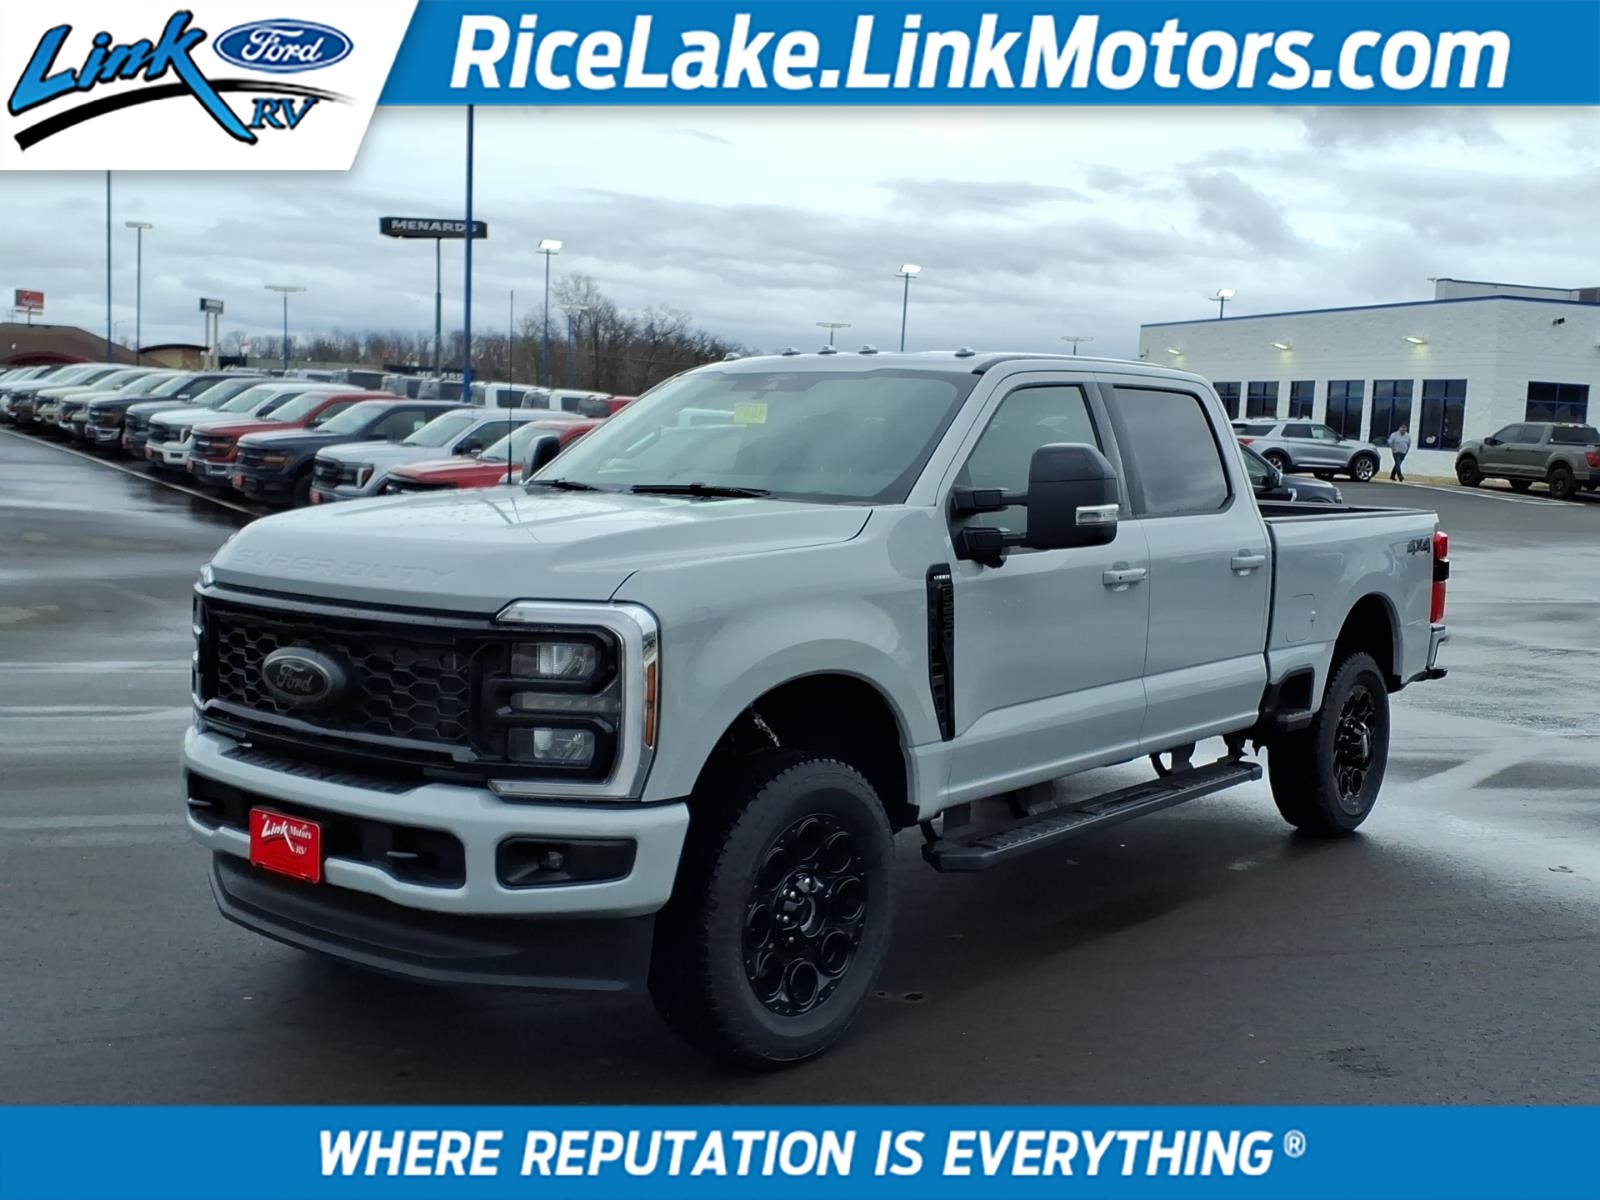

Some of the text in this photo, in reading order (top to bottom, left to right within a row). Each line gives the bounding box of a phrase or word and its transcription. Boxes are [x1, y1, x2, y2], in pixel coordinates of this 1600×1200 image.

[232, 550, 456, 588] SUPER DUTY
[277, 664, 314, 692] Ford
[261, 820, 312, 852] Link Motors
